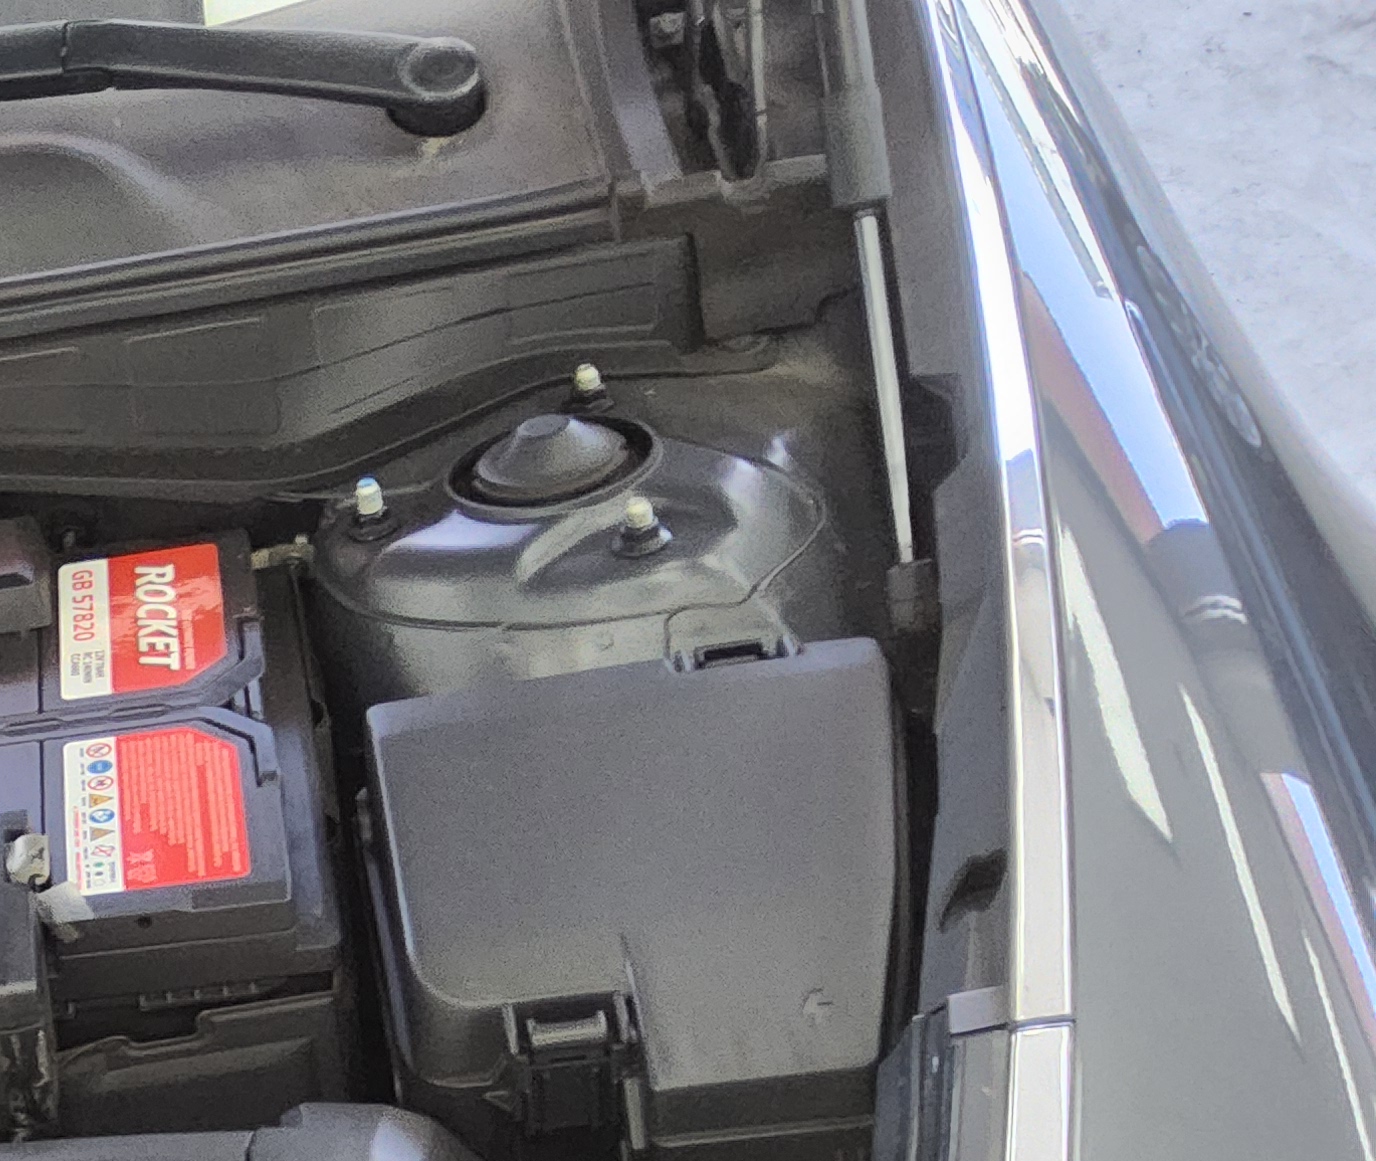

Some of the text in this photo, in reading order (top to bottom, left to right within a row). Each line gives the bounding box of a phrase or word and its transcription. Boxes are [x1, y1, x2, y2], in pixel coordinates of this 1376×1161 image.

[72, 570, 96, 642] GB 57820
[134, 563, 181, 671] ROCKET
